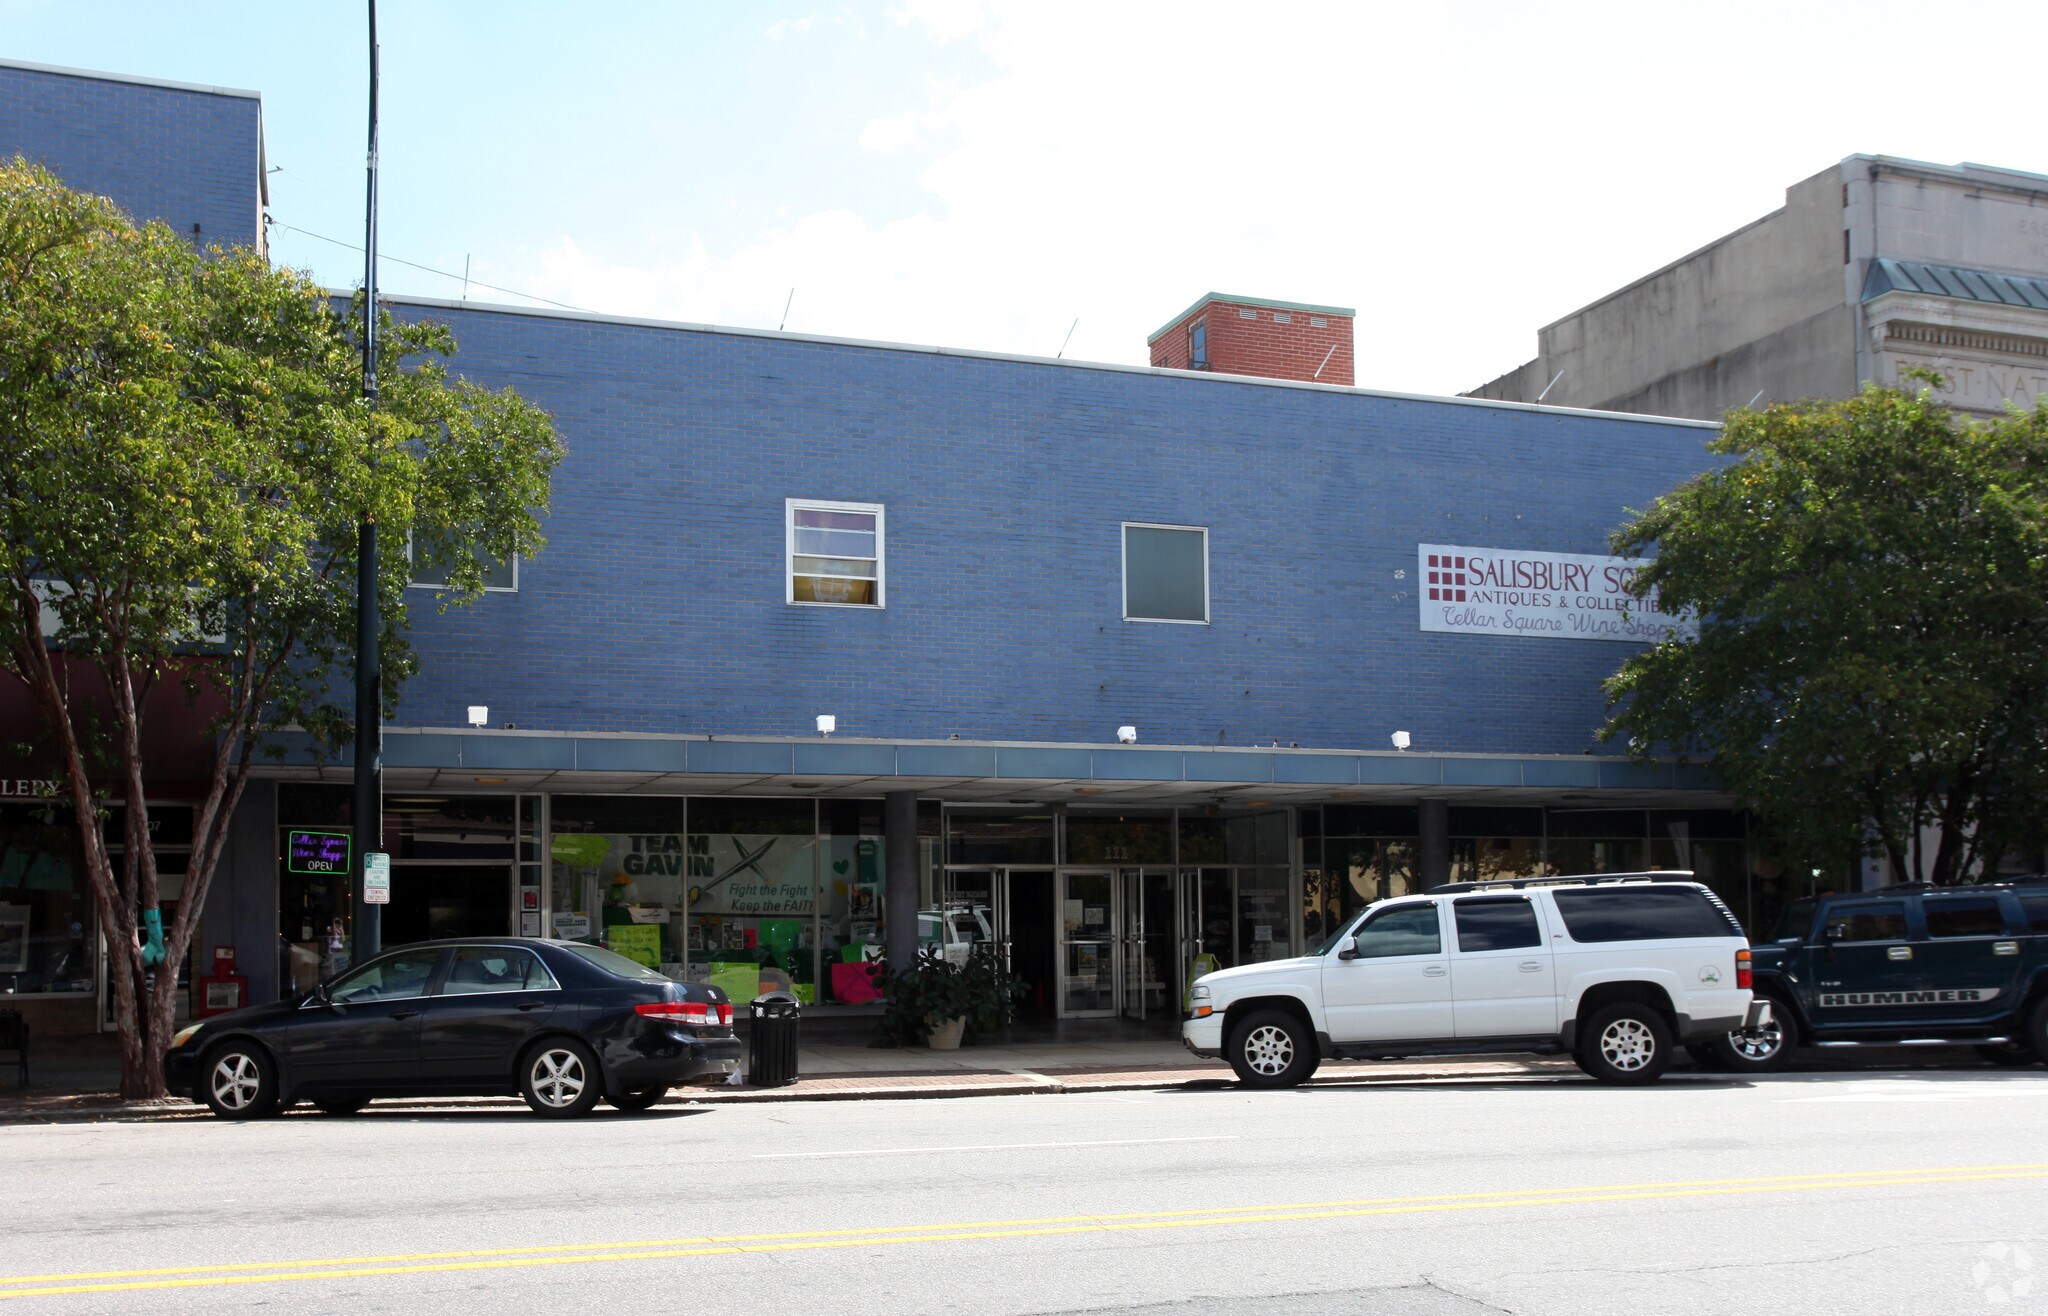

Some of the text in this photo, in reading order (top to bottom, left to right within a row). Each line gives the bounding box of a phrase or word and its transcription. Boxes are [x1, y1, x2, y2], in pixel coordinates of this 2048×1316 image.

[1468, 557, 1595, 592] SALISBURY
[1470, 590, 1691, 615] ANTIQUES & COLLECTIBS
[1442, 606, 1498, 628] Cellar
[1503, 609, 1563, 633] Square
[1567, 612, 1619, 634] Wine
[628, 835, 709, 855] TEAM
[1105, 847, 1128, 859] 111
[308, 861, 333, 871] OPEN
[623, 854, 714, 877] GAVIN
[729, 883, 807, 898] Fight the Fight
[731, 899, 759, 912] Keep
[763, 900, 780, 911] the
[1823, 990, 1980, 1006] HUMMER
